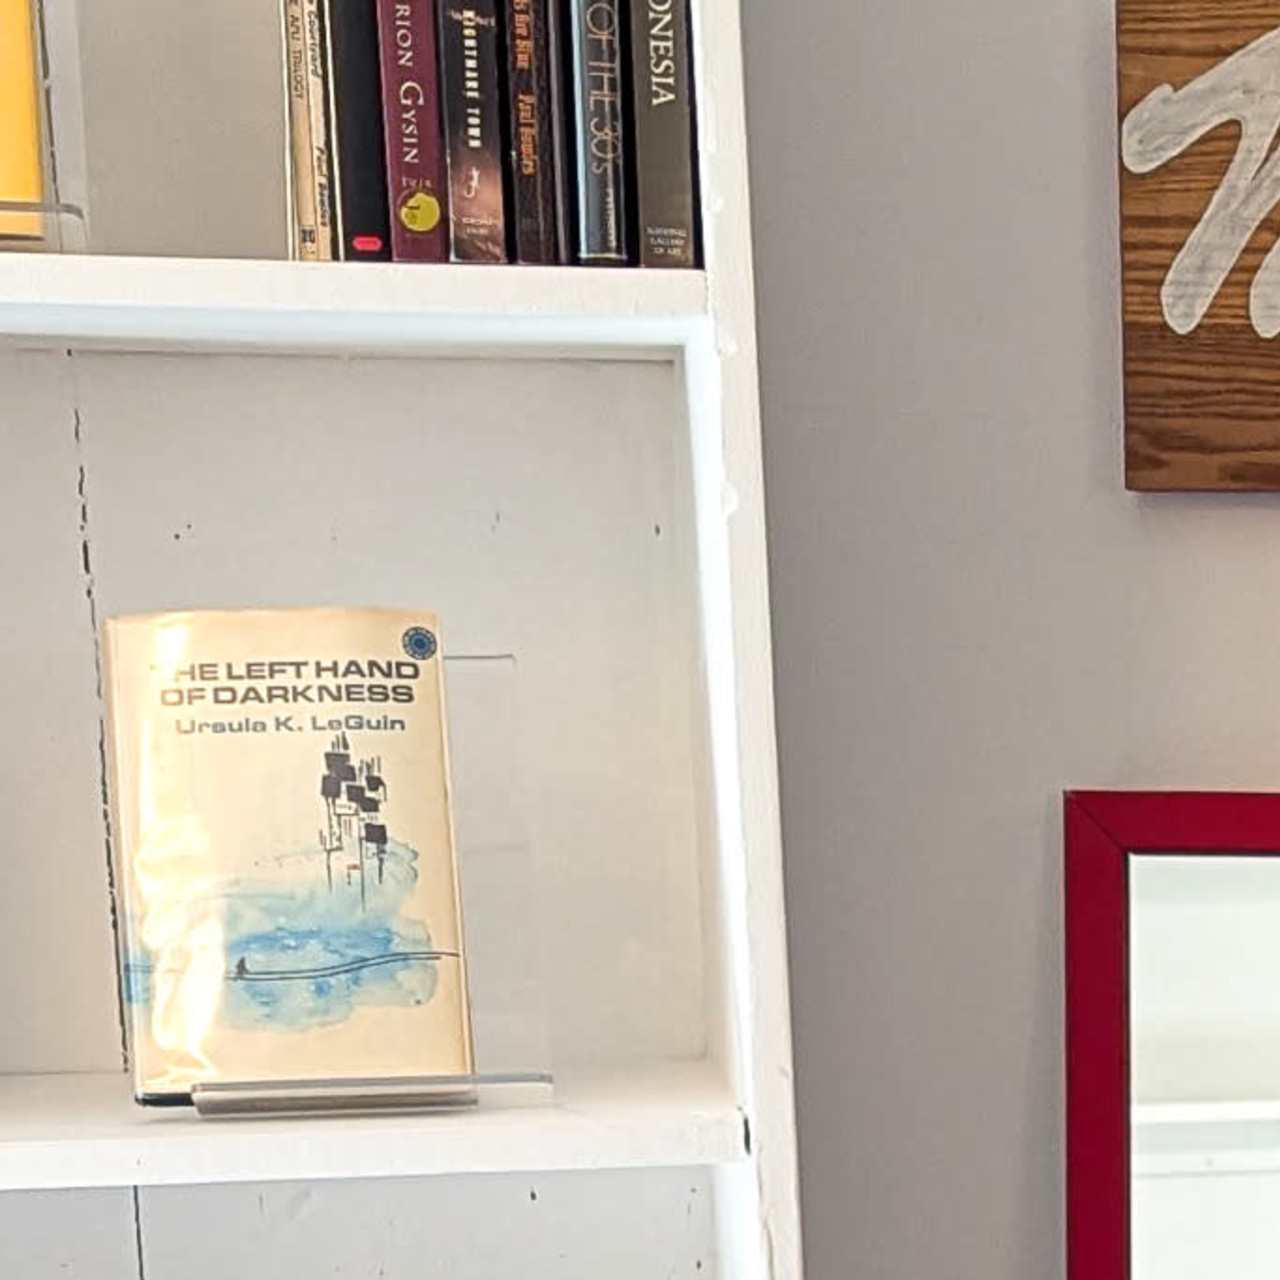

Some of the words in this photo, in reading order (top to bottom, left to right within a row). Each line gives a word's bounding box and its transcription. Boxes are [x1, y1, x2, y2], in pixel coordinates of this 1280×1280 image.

[395, 3, 413, 67] RION
[648, 0, 677, 107] ONESIA
[164, 662, 219, 682] HE
[225, 660, 310, 682] LEFT
[314, 659, 421, 680] HAND
[161, 688, 207, 707] OF
[211, 684, 416, 706] DARKNESS
[174, 716, 267, 735] Ursula
[274, 716, 304, 733] K.
[311, 714, 407, 733] LeGuin
